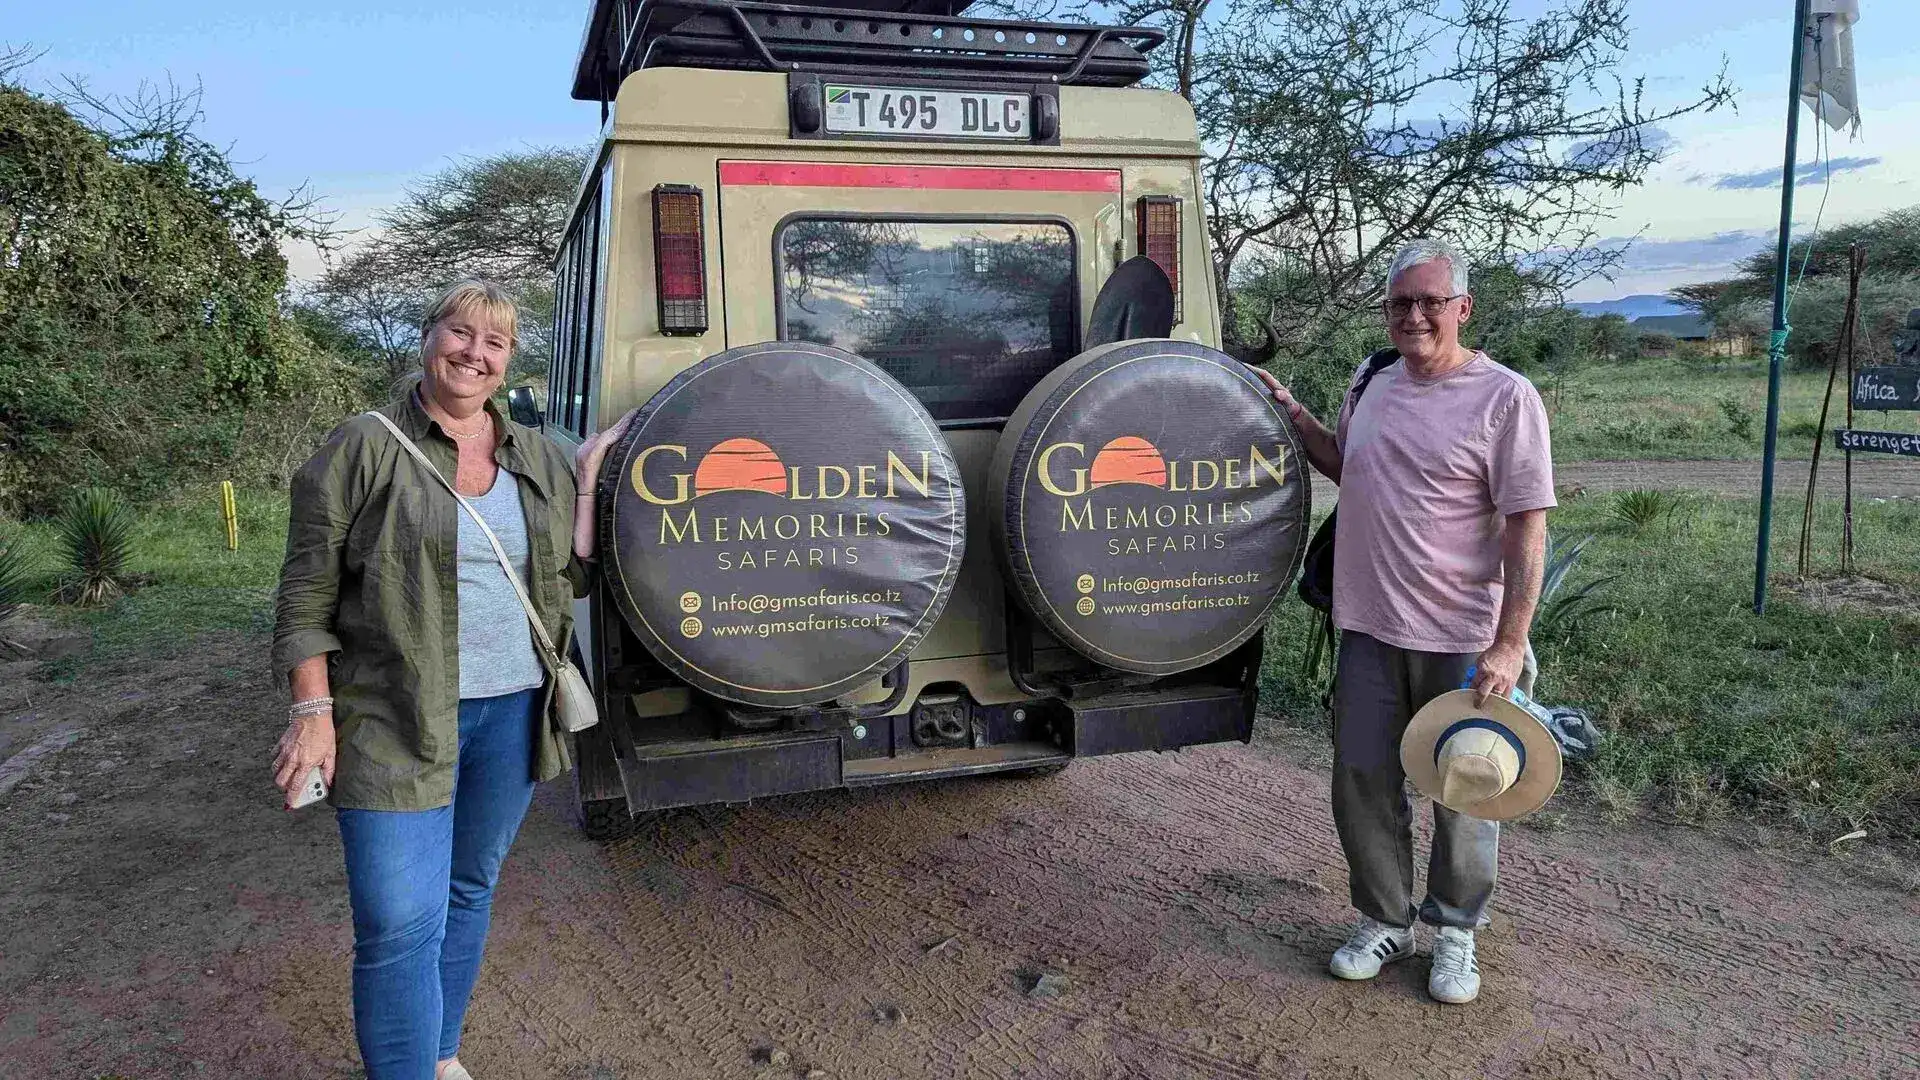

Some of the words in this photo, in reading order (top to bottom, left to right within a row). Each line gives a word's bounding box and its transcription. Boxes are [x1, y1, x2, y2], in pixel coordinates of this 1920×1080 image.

[852, 92, 870, 127] T
[879, 93, 937, 130] 495
[960, 97, 1021, 133] DLC
[1856, 375, 1899, 402] Africa
[658, 507, 891, 545] MEMORIES
[1060, 499, 1252, 532] MEMORIES
[1108, 533, 1225, 555] SAFARIS
[718, 547, 859, 570] SAFARIS
[1103, 571, 1260, 594] Info@gmsafaris.co.tz
[712, 588, 901, 614] Info@gmsafaris.co.tz
[1103, 594, 1250, 616] www.gmsafaris.co.tz
[712, 613, 890, 638] www.gmsafaris.co.tz
